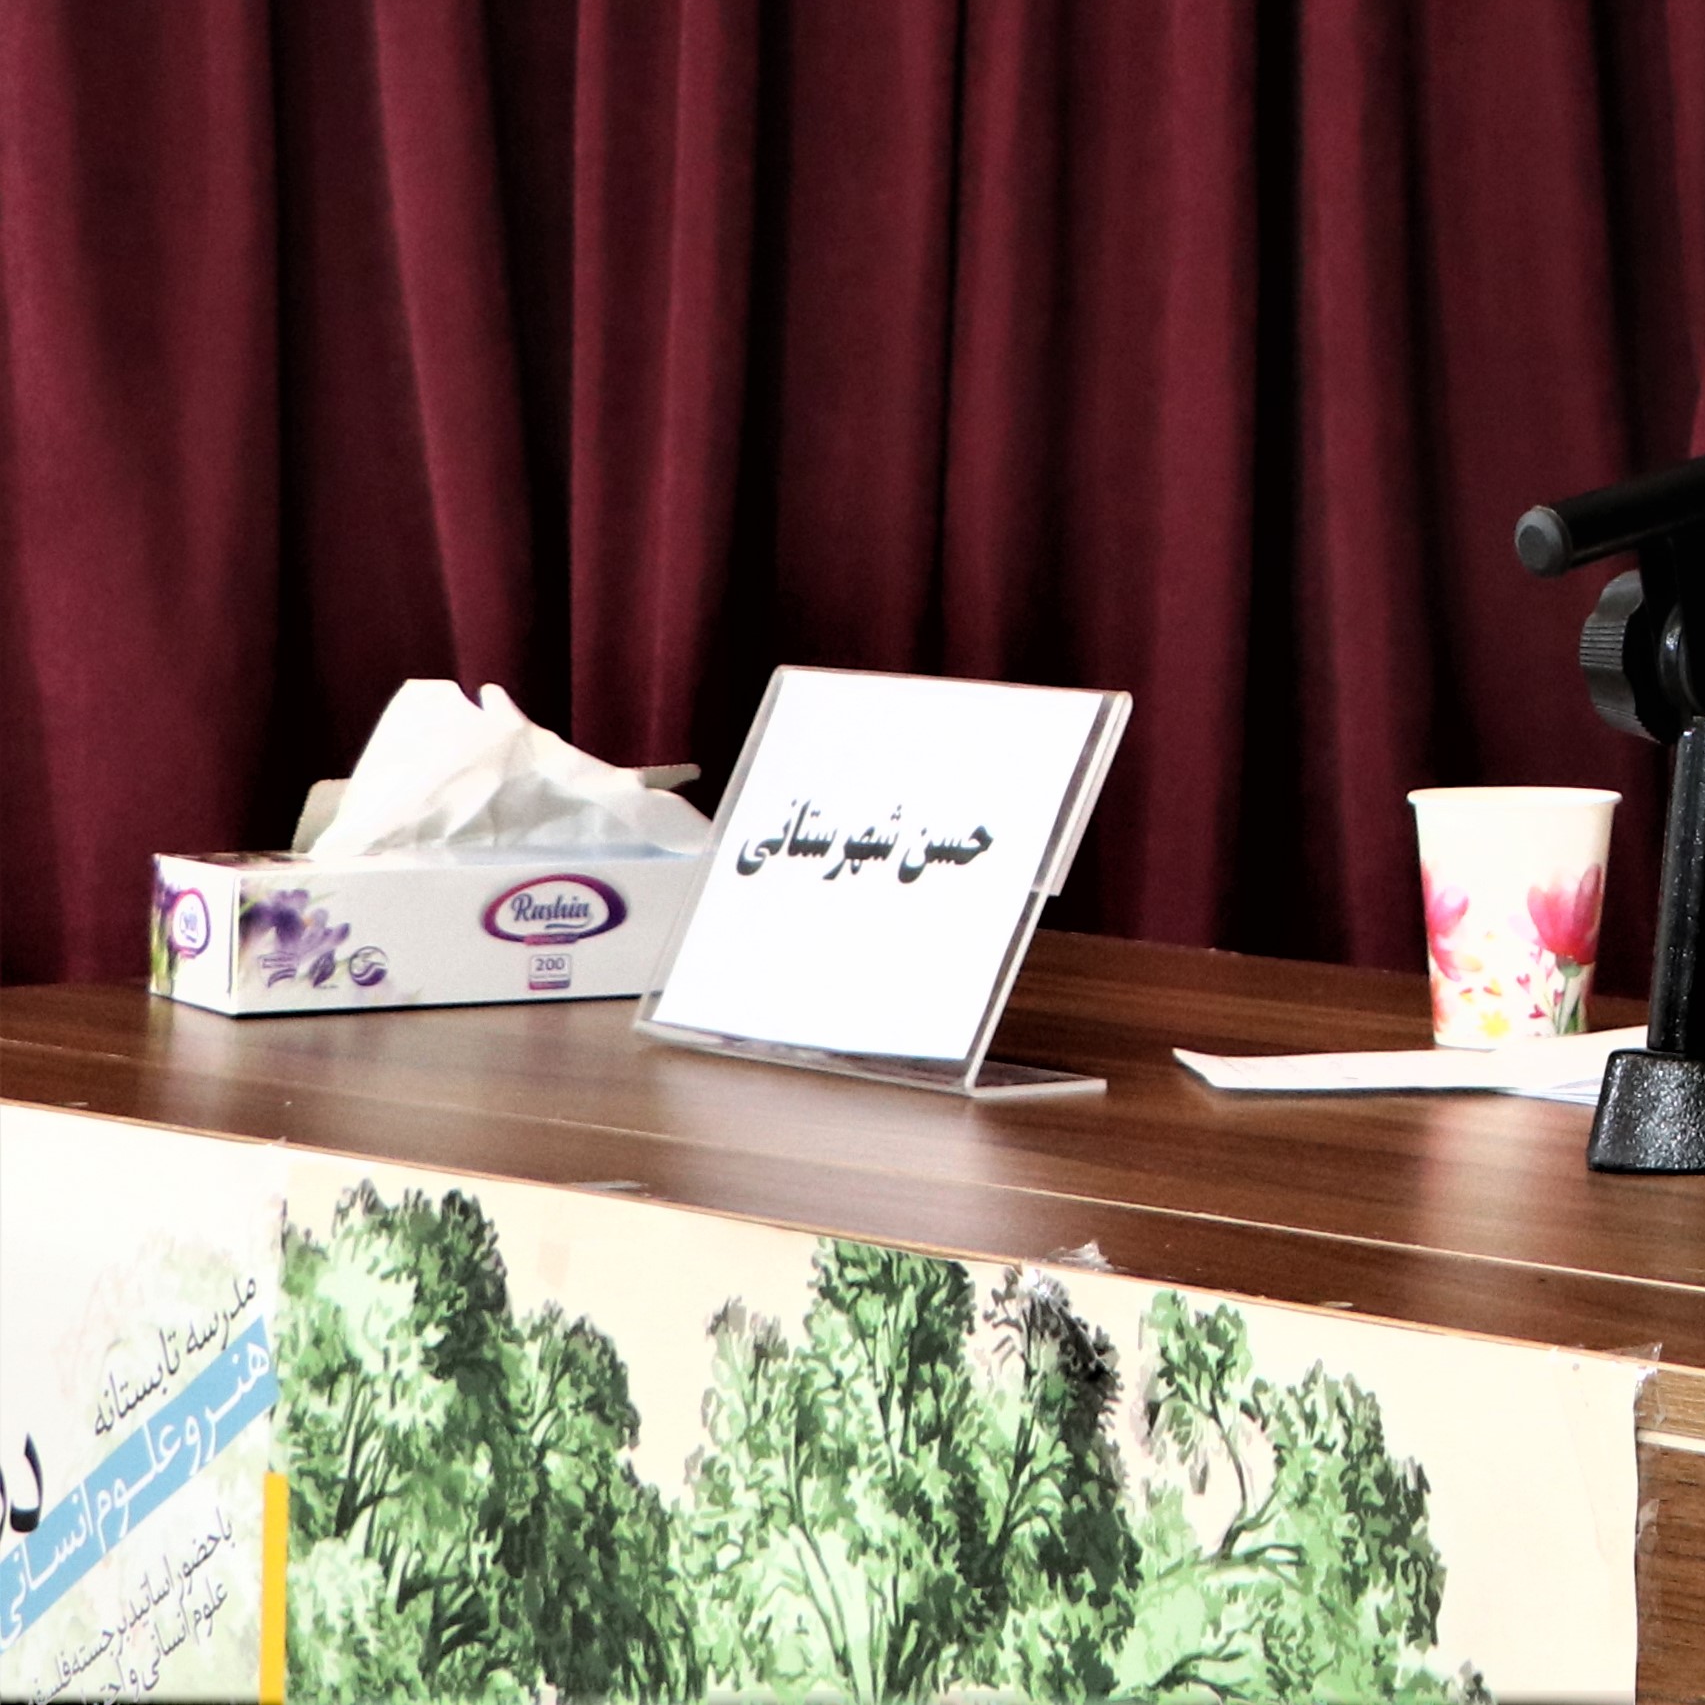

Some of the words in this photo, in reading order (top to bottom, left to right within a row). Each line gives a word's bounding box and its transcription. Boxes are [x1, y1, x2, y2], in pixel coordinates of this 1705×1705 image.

[736, 798, 902, 881] شهرستانی
[898, 827, 994, 884] حسن
[535, 957, 565, 971] 200
[186, 1277, 256, 1355] مدرسه
[94, 1328, 180, 1436] تابستانه
[204, 1342, 270, 1463] هنر
[185, 1415, 202, 1477] و
[97, 1423, 182, 1554] علوم
[214, 1506, 236, 1548] با
[177, 1537, 222, 1605] حضور
[193, 1575, 228, 1647] علوم
[142, 1607, 190, 1692] انسانی
